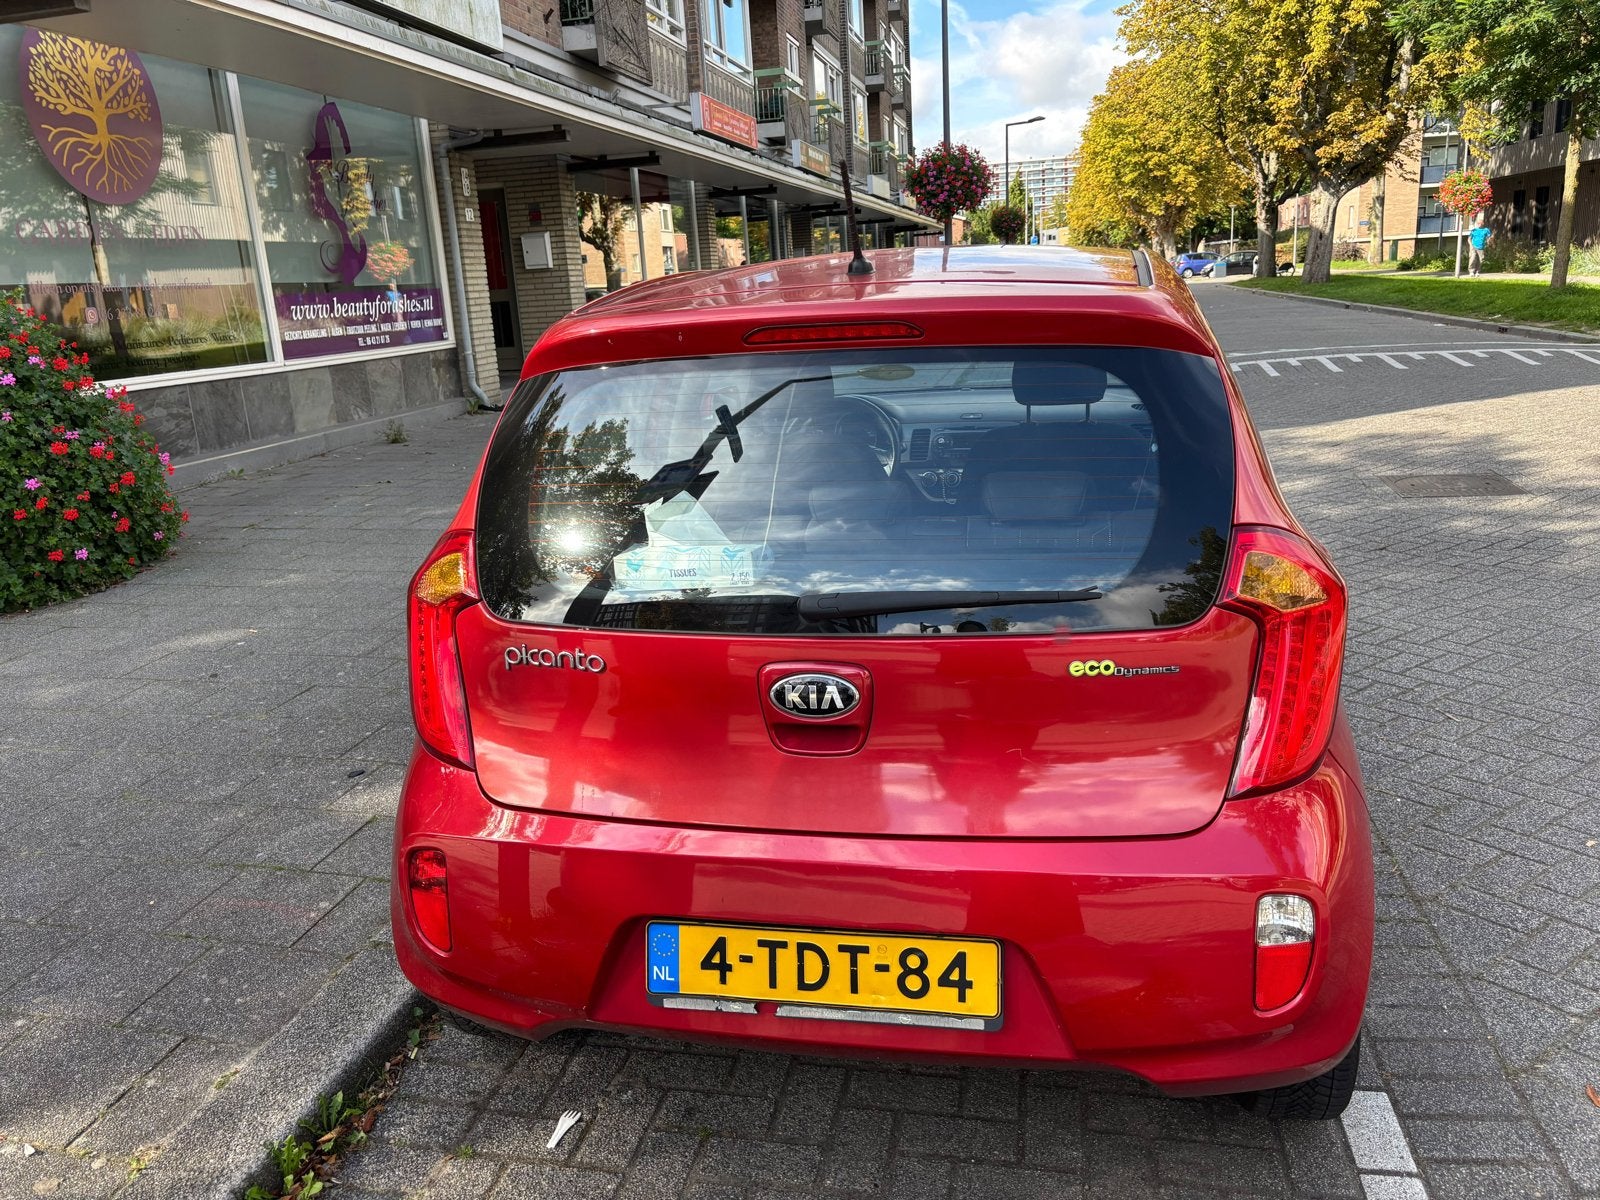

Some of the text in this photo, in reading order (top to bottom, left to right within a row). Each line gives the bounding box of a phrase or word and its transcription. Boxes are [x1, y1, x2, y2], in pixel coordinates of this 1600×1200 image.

[65, 284, 78, 295] op
[290, 294, 434, 322] www.beautyforashes.nl
[669, 568, 697, 578] TISSUES
[504, 643, 607, 674] picanto
[784, 684, 845, 709] KIA
[653, 965, 675, 981] NL
[699, 935, 974, 1004] 4-TDT-84
